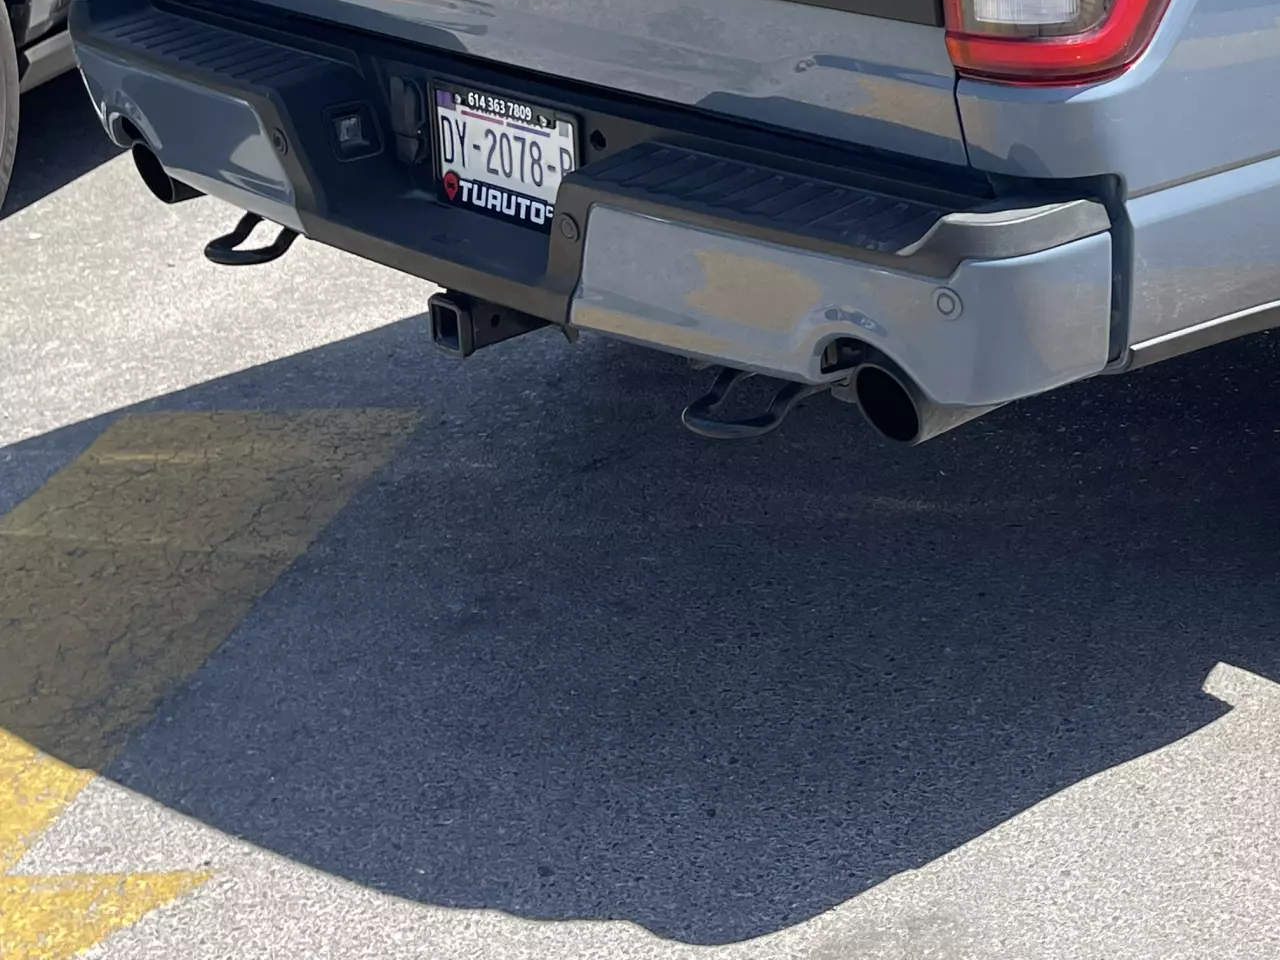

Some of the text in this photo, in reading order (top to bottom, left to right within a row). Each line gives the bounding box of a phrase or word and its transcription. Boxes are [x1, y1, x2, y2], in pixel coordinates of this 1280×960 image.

[468, 92, 486, 109] 614
[487, 96, 506, 114] 363
[507, 102, 532, 120] 7809
